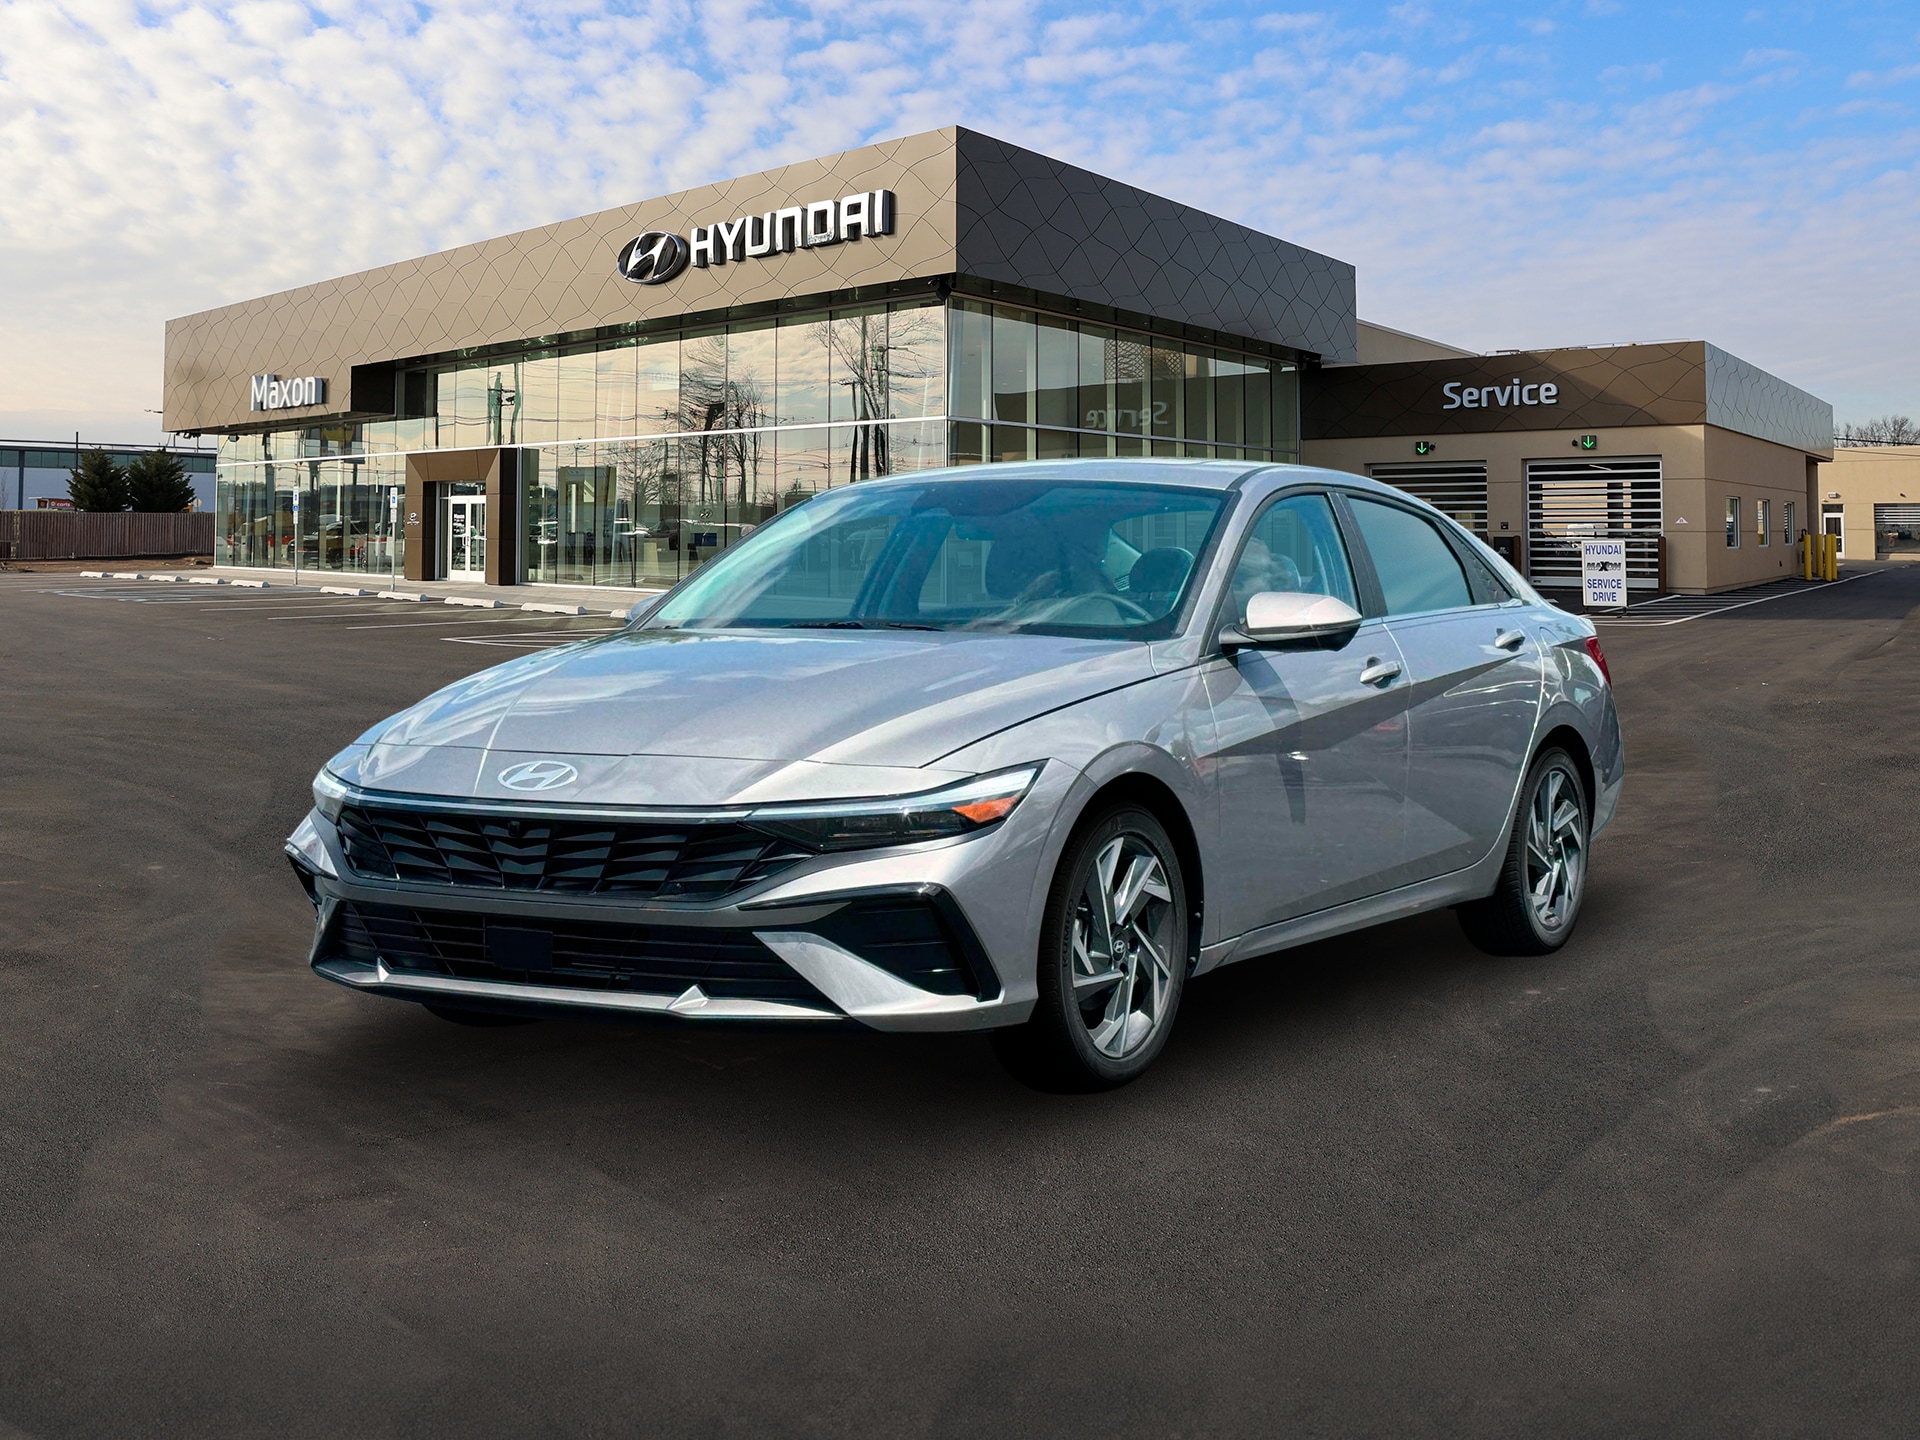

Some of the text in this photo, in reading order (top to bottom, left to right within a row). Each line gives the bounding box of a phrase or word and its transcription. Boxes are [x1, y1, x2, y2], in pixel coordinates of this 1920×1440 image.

[690, 189, 892, 267] HYUNDAI
[250, 373, 322, 411] Maxon
[1443, 378, 1558, 409] Service
[1585, 545, 1622, 555] HYUNDAI
[1586, 561, 1621, 571] MAXON
[1587, 579, 1622, 589] SERVICE
[1592, 592, 1617, 602] DRIVE
